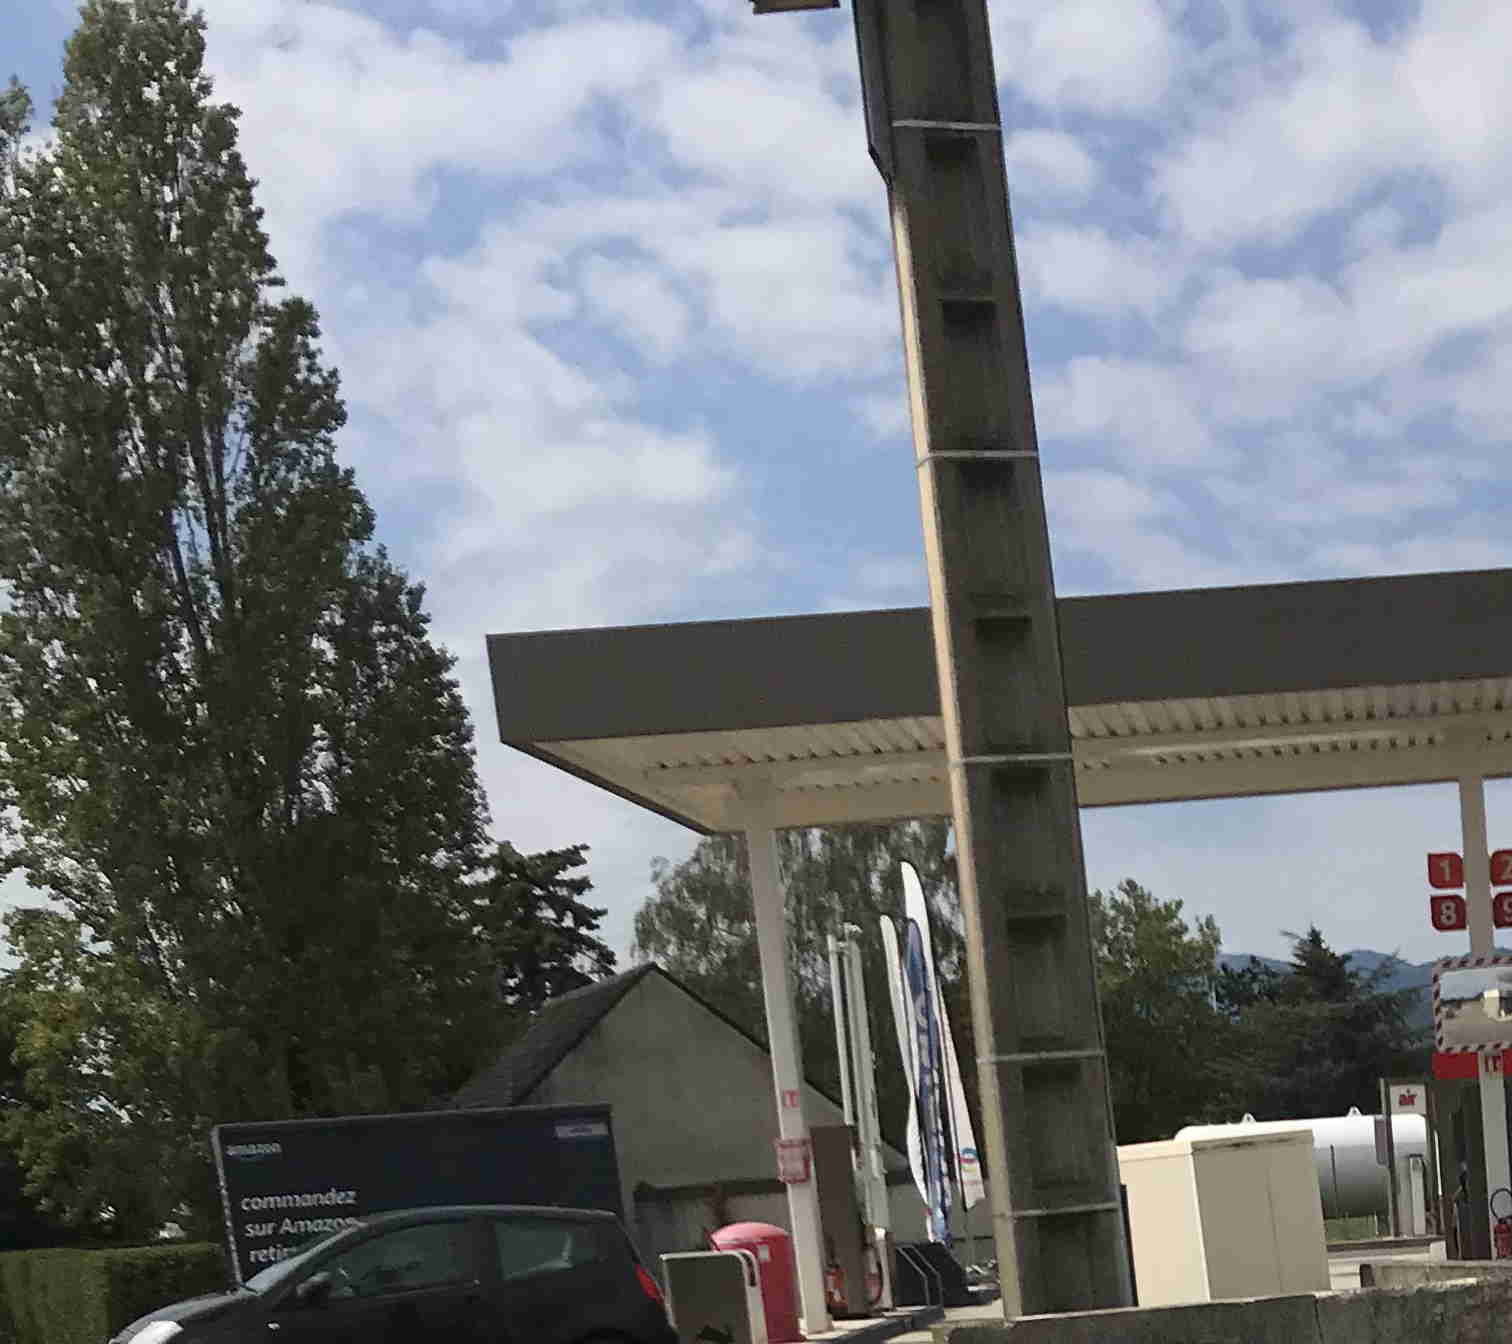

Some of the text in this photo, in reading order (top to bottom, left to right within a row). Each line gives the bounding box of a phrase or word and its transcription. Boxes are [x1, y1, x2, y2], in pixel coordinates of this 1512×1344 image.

[1440, 858, 1452, 881] 1
[1440, 901, 1457, 926] 8
[1399, 1088, 1418, 1106] air
[241, 1186, 358, 1211] commandez
[244, 1222, 277, 1238] sur
